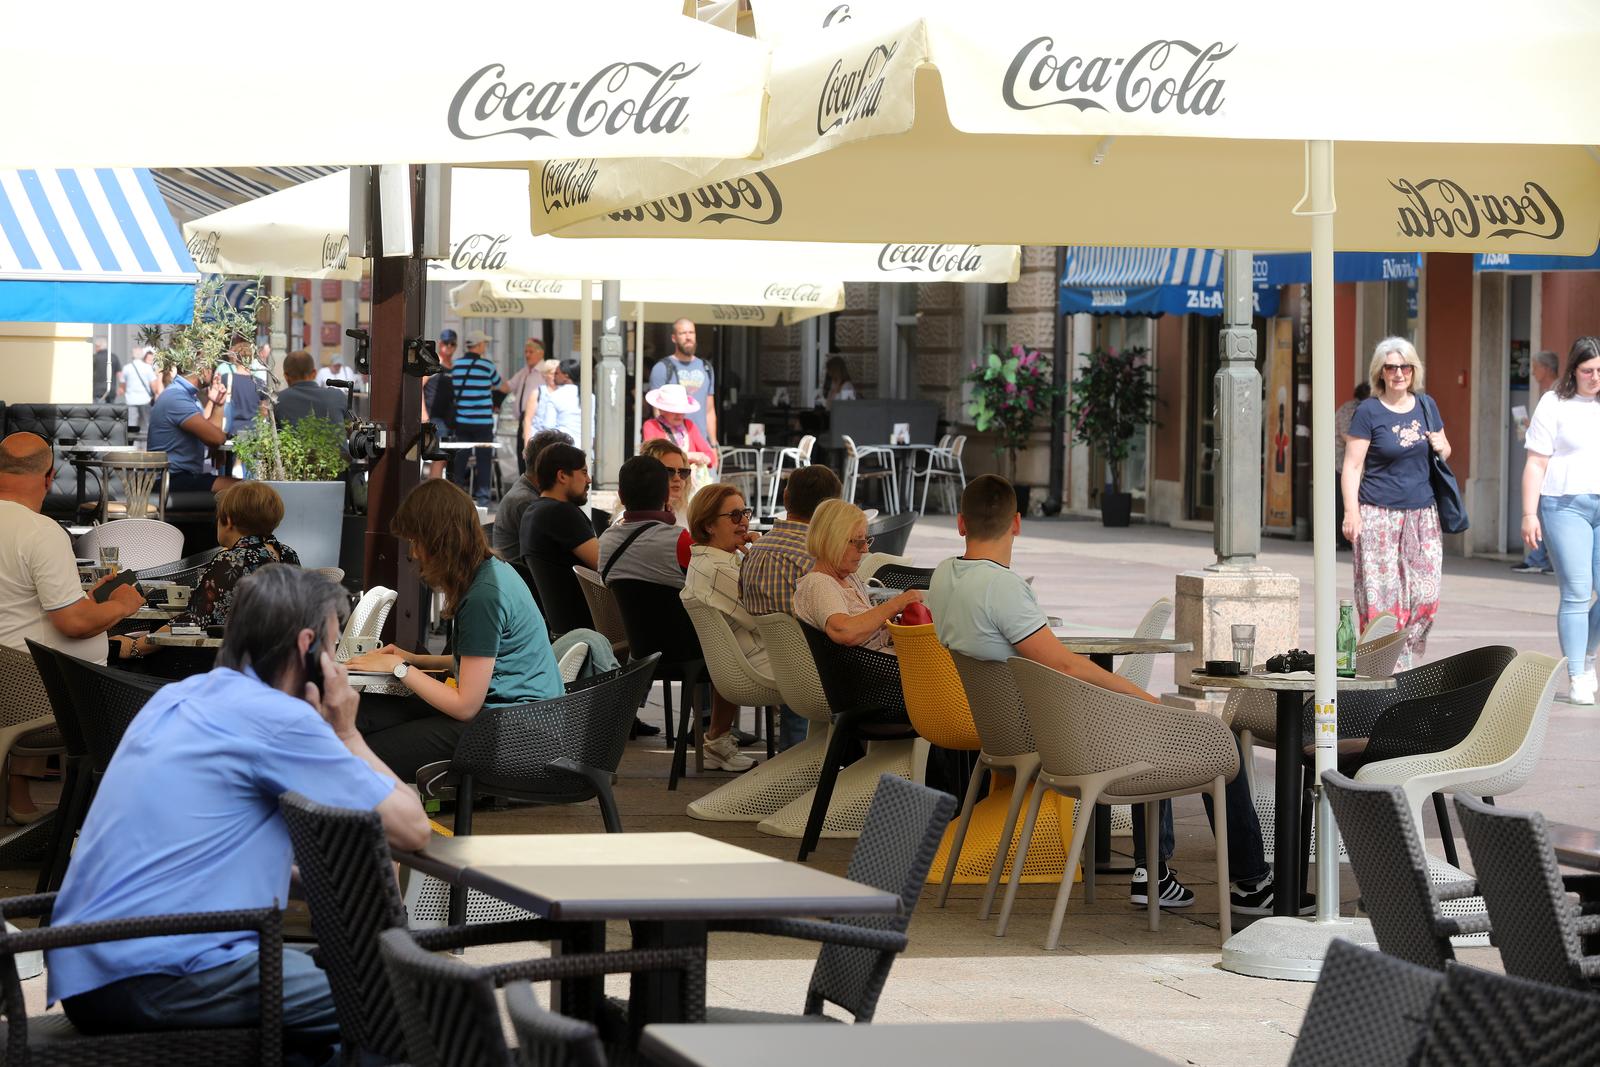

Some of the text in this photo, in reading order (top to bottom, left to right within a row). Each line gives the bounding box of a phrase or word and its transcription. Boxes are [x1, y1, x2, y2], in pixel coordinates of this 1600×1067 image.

[447, 62, 702, 141] Coca-Cola
[1002, 36, 1238, 116] Coca-Cola
[1186, 289, 1262, 312] ZLAR
